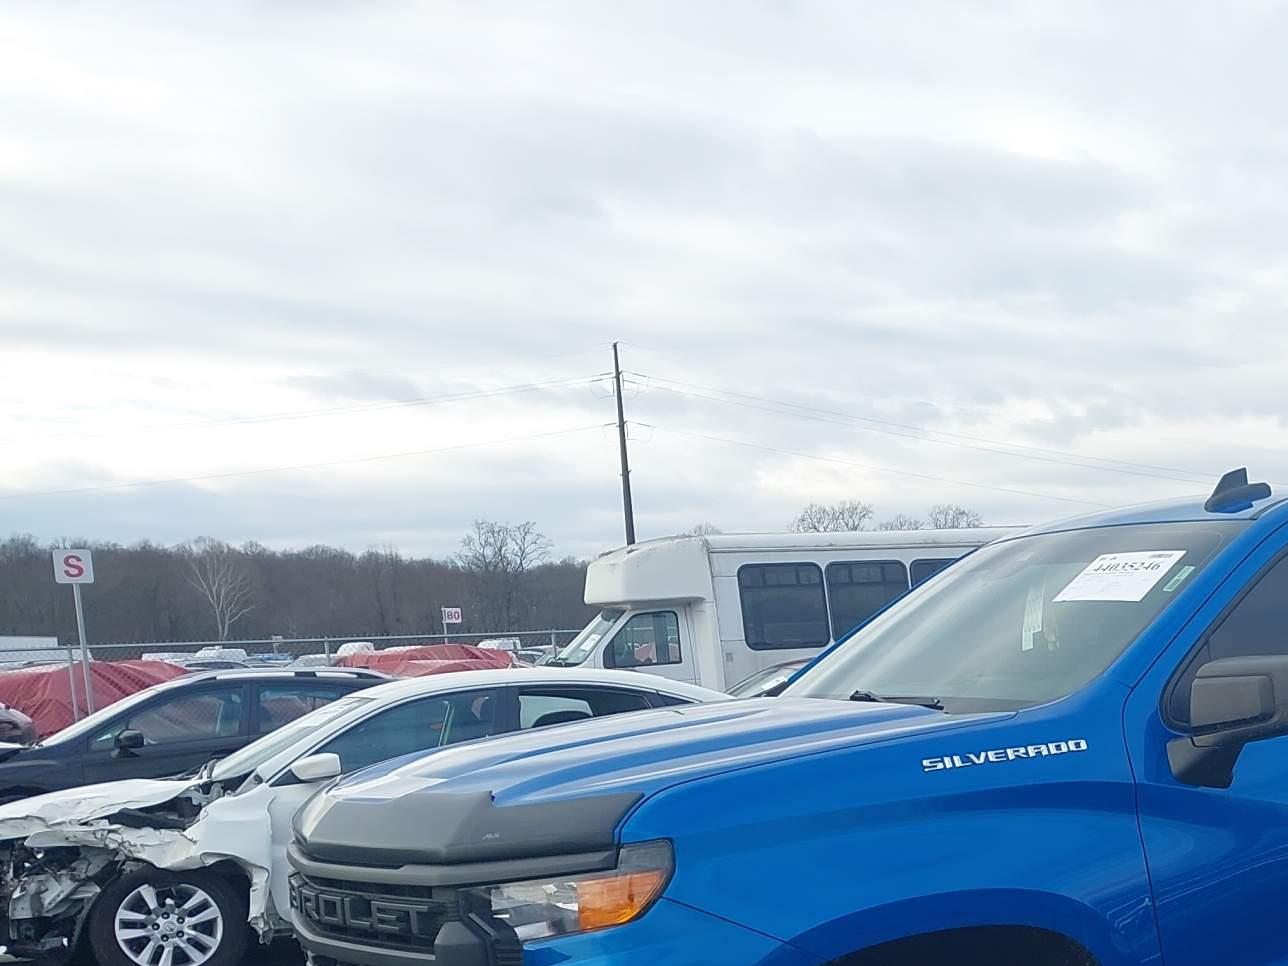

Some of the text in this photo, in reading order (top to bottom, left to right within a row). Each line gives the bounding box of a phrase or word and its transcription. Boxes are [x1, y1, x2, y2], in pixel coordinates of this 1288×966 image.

[63, 554, 84, 578] S
[1093, 561, 1161, 572] 44035246
[921, 738, 1088, 772] SILVERADO
